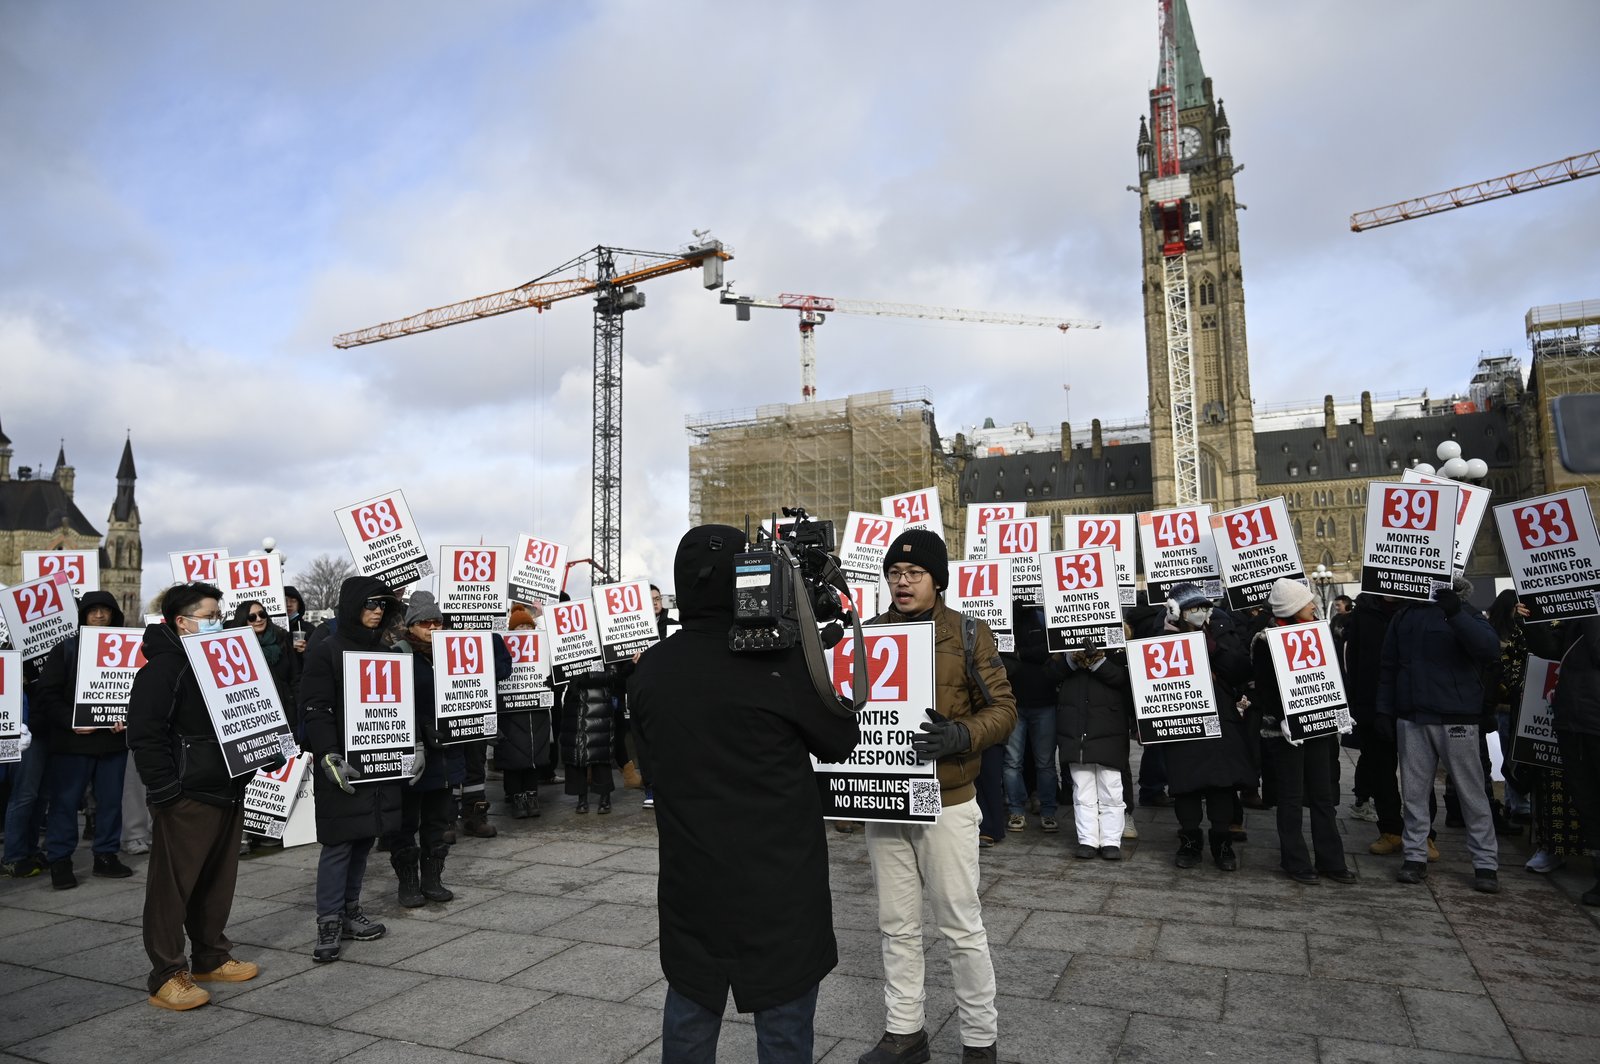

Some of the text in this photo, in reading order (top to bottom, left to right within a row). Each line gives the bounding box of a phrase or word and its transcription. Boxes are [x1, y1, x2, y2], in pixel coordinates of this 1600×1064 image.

[896, 495, 925, 523] 34
[1388, 489, 1431, 529] 39
[359, 502, 396, 538] 68
[1232, 509, 1272, 547] 31
[1521, 502, 1569, 547] 33
[860, 518, 888, 546] 72
[1082, 521, 1116, 548] 22
[1158, 513, 1197, 546] 46
[368, 533, 401, 550] MONTHS
[1002, 524, 1033, 553] 40
[1386, 532, 1429, 544] MONTHS
[363, 539, 413, 562] WAITING FOR
[528, 540, 555, 567] 30
[1162, 547, 1197, 558] MONTHS
[1238, 545, 1276, 560] MONTHS
[1375, 543, 1440, 557] WAITING FOR
[1530, 547, 1576, 563] MONTHS
[187, 554, 215, 580] 27
[458, 552, 491, 581] 68
[525, 564, 550, 575] MONTHS
[1154, 555, 1207, 568] WAITING FOR
[1231, 553, 1288, 572] WAITING FOR
[1522, 557, 1592, 577] WAITING FOR
[234, 560, 268, 589] 19
[390, 569, 418, 585] RESULTS
[517, 569, 555, 584] WAITING FOR
[1062, 554, 1097, 590] 53
[1377, 571, 1433, 584] NO TIMELINES
[964, 566, 993, 596] 71
[1380, 580, 1429, 593] NO RESULTS
[20, 583, 58, 621] 22
[236, 590, 267, 599] MONTHS
[609, 586, 640, 615] 30
[1062, 591, 1099, 602] MONTHS
[1534, 595, 1549, 604] NO
[962, 600, 993, 608] MONTHS
[1055, 601, 1109, 613] WAITING FOR
[1541, 599, 1596, 614] NO RESULTS
[28, 615, 62, 633] MONTHS
[558, 606, 584, 634] 30
[607, 620, 649, 633] WAITING FOR
[613, 614, 640, 624] MONTHS
[23, 628, 56, 646] WAITING
[57, 621, 73, 633] FOR
[561, 633, 586, 643] MONTHS
[103, 634, 143, 667] 37
[507, 635, 535, 662] 34
[556, 642, 580, 653] WAITING
[1287, 630, 1321, 670] 23
[209, 638, 251, 686] 39
[451, 638, 478, 674] 19
[1148, 641, 1188, 678] 34
[366, 661, 396, 702] 11
[452, 678, 480, 688] MONTHS
[1295, 671, 1325, 684] MONTHS
[1152, 680, 1191, 692] MONTHS
[1290, 680, 1335, 697] WAITING FOR
[225, 686, 260, 704] MONTHS
[445, 689, 487, 701] WAITING FOR
[1144, 689, 1202, 703] WAITING FOR
[221, 698, 272, 720] WAITING FOR
[365, 708, 397, 718] MONTHS
[356, 720, 405, 731] WAITING FOR
[448, 719, 457, 728] NO
[1151, 716, 1203, 728] NO TIMELINES
[1298, 715, 1308, 724] NO
[1303, 718, 1338, 732] NO RESULTS
[451, 725, 484, 737] NO RESULTS
[1156, 725, 1201, 736] NO RESULTS
[236, 731, 280, 753] NO TIMELINES
[243, 743, 281, 764] NO RESULTS
[360, 753, 370, 763] NO
[364, 761, 401, 773] NO RESULTS
[830, 778, 910, 793] NO TIMELINES
[835, 795, 905, 810] NO RESULTS
